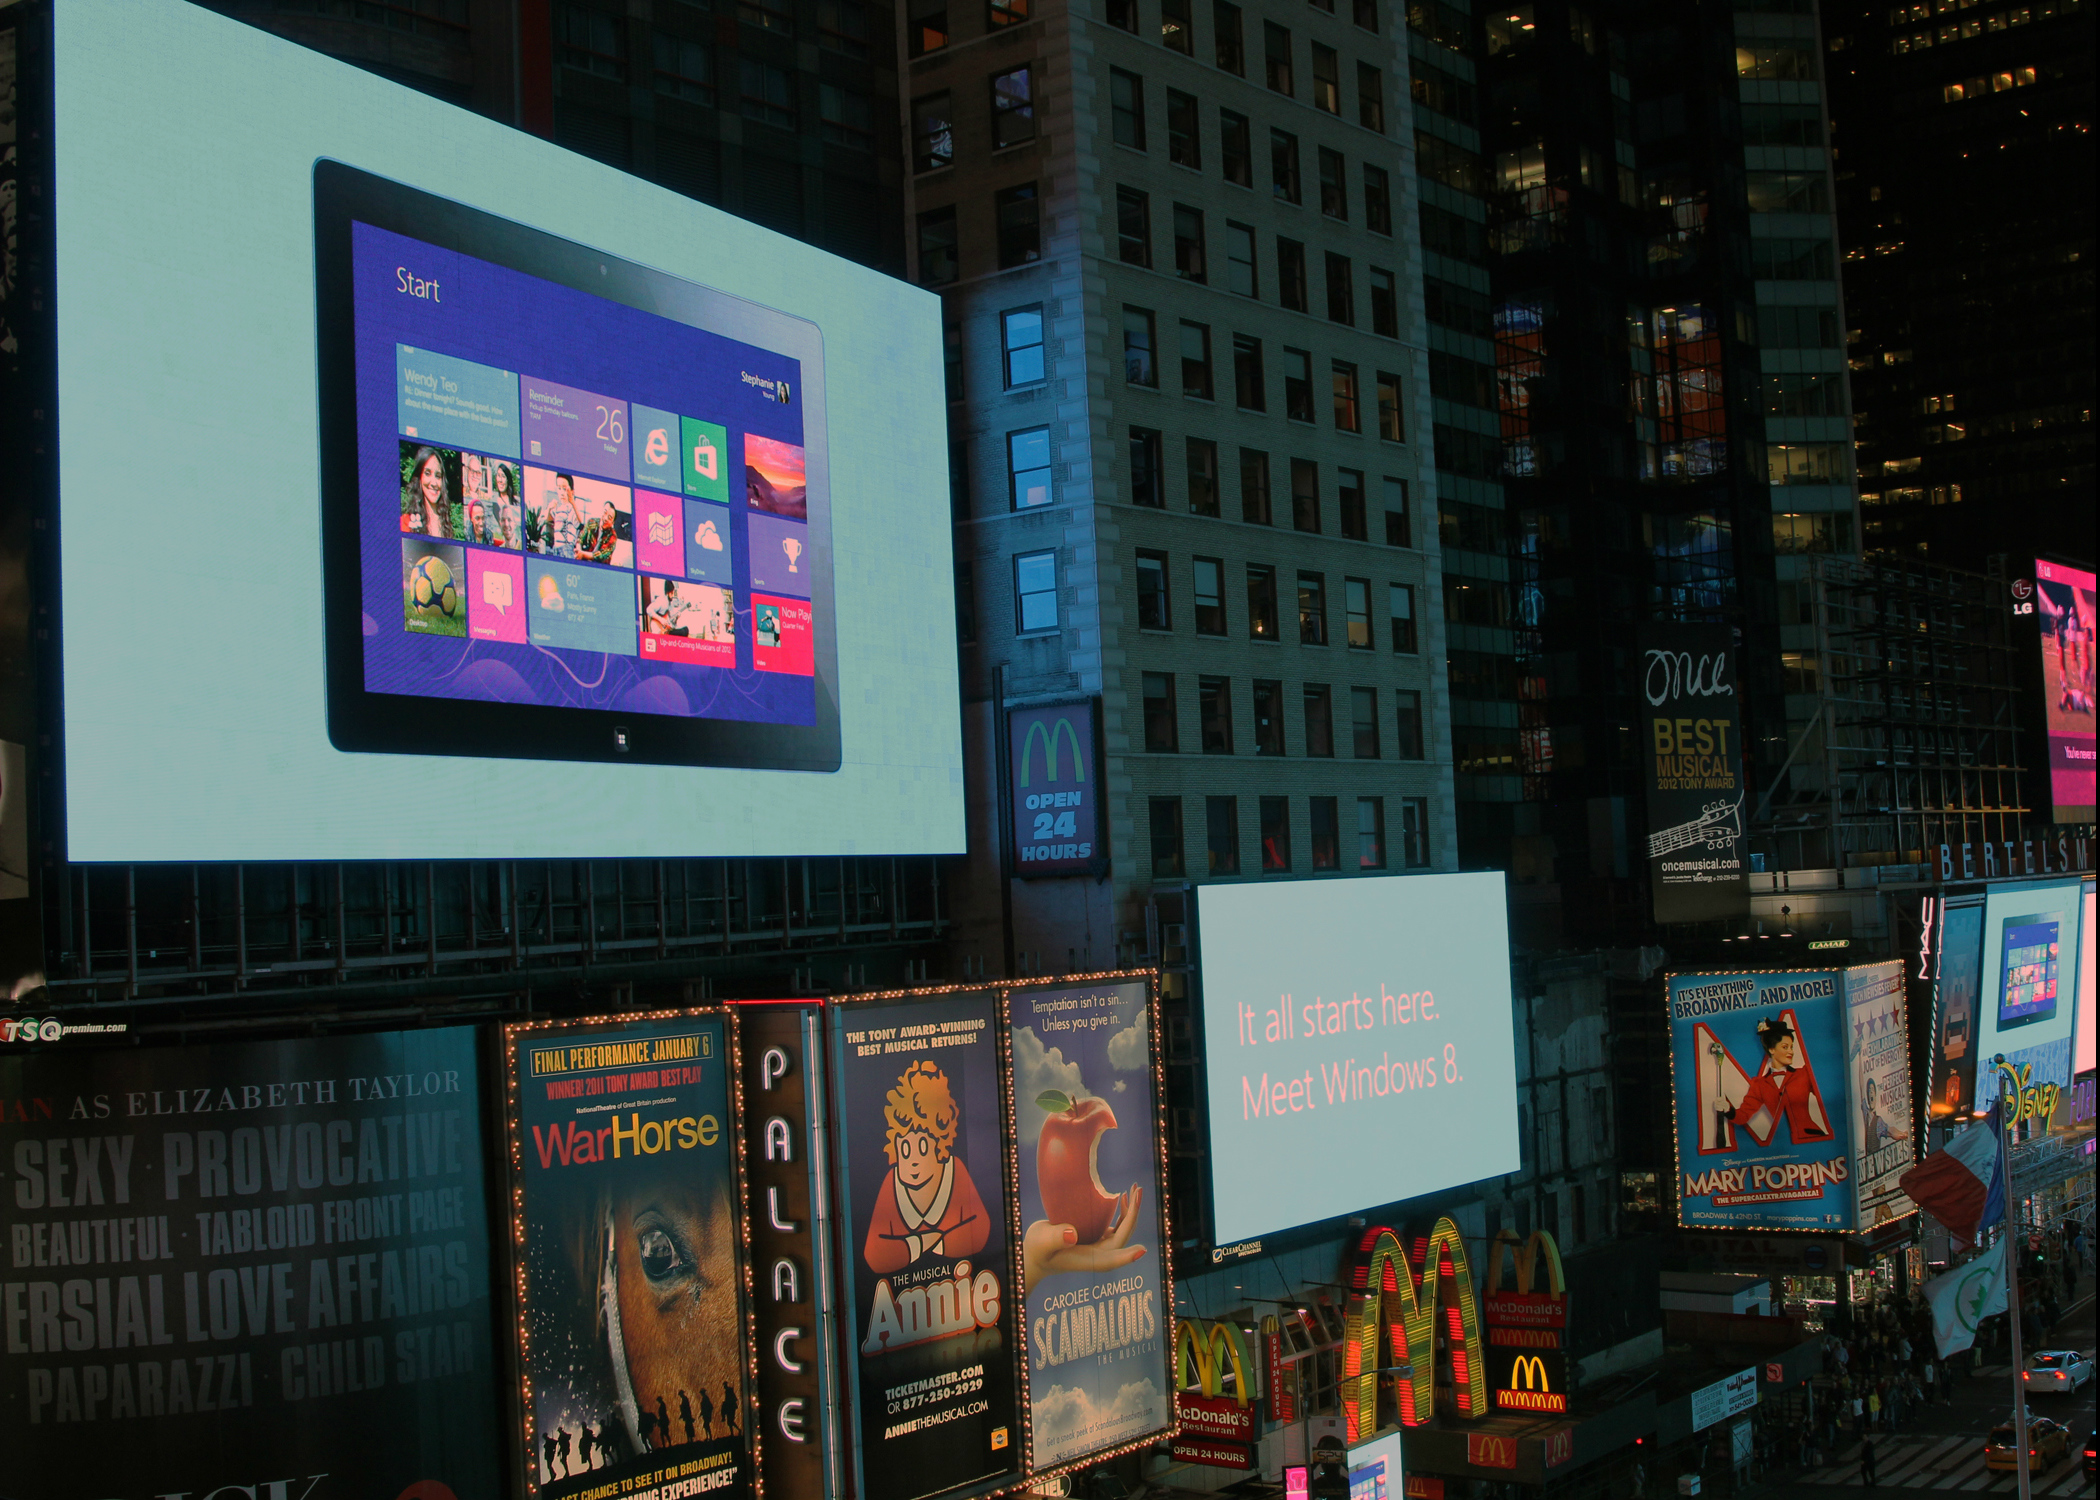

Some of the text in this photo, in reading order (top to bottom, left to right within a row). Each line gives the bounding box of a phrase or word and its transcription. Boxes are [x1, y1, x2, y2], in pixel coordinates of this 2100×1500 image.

[396, 266, 441, 303] Start
[404, 367, 458, 393] Wendy Teo
[741, 370, 775, 390] Stephanie
[529, 388, 564, 408] Reminder
[596, 405, 624, 443] 26
[781, 606, 796, 619] Now
[2014, 602, 2033, 615] LG
[473, 625, 497, 636] Messaging
[659, 637, 722, 653] Up-and-Coming Musicians of
[1653, 718, 1731, 755] BEST
[1656, 755, 1734, 778] MUSICAL
[1657, 778, 1735, 790] 2012 TONY AWARD
[1025, 791, 1081, 810] OPEN
[1033, 811, 1077, 840] 24
[1022, 843, 1091, 861] HOURS
[1661, 857, 1740, 872] oncemusical.com
[1940, 837, 2088, 881] BERTELSM
[1811, 940, 1846, 949] LAMAR
[1677, 979, 1754, 1002] IT'S EVERYTHING
[1760, 986, 1790, 1006] AND
[1790, 979, 1835, 1002] MORE!
[1031, 992, 1129, 1016] Temptation isn't a sin...
[1238, 982, 1440, 1046] It all starts here.
[846, 1019, 986, 1044] THE TONY AWARD-WINNING
[1042, 1011, 1121, 1032] Unless you give in.
[534, 1035, 710, 1074] FINAL PERFORMANCE JANUARY 6
[857, 1032, 977, 1057] BEST MUSICAL RETURNS!
[546, 1065, 703, 1101] WINNER! 2011 TONY AWARD BEST PLAY
[1242, 1042, 1463, 1120] Meet Windows 8.
[69, 1070, 462, 1120] AS ELIZABETH TAYLOR
[616, 1102, 623, 1110] of
[623, 1100, 637, 1110] Great
[636, 1098, 652, 1108] Britain
[652, 1096, 677, 1107] production
[1880, 1085, 1906, 1108] MUSICAL
[14, 1110, 463, 1210] SEXY PROVOCATIVE
[1721, 1157, 1743, 1168] Disney
[1857, 1139, 1911, 1187] NEWSIES
[1685, 1166, 1748, 1198] MARY
[1751, 1156, 1849, 1191] POPPINS
[1730, 1189, 1819, 1204] SUPERCALEXTRAVAGANZA!
[12, 1186, 465, 1268] BEAUTIFUL TABLOID FRONT PAGE
[1692, 1211, 1752, 1220] BROADWAY & 42ND
[1766, 1214, 1819, 1223] marypoppins.com
[761, 1044, 804, 1443] PALACE
[893, 1264, 952, 1287] THE MUSICAL
[0, 1240, 469, 1355] ERSIAL LOVE AFFAIRS
[1043, 1275, 1144, 1312] CAROLEE CARMELLO
[861, 1260, 1002, 1358] Annie
[1487, 1302, 1562, 1316] McDonald's
[1500, 1313, 1550, 1324] Restaurant
[1033, 1289, 1156, 1371] SCANDALOUS
[1097, 1340, 1157, 1366] THE MUSICAL
[28, 1321, 475, 1424] PAPARAZZI CHILD STAR
[885, 1364, 984, 1400] TICKETMASTER.COM
[1272, 1369, 1280, 1377] 24
[887, 1378, 983, 1415] OR 877-250-2929
[884, 1400, 989, 1440] ANNIETHEMUSICAL.COM
[1046, 1436, 1057, 1447] Get
[1060, 1429, 1076, 1443] sneak
[1076, 1426, 1089, 1440] peek
[1089, 1424, 1095, 1434] at
[1094, 1407, 1153, 1432] ScandalousBroadway.com
[1182, 1421, 1236, 1436] Restaurant
[1173, 1445, 1246, 1464] OPEN 24 HOURS
[580, 1451, 733, 1500] CHANCE TO SEE IT ON BROADWAY!
